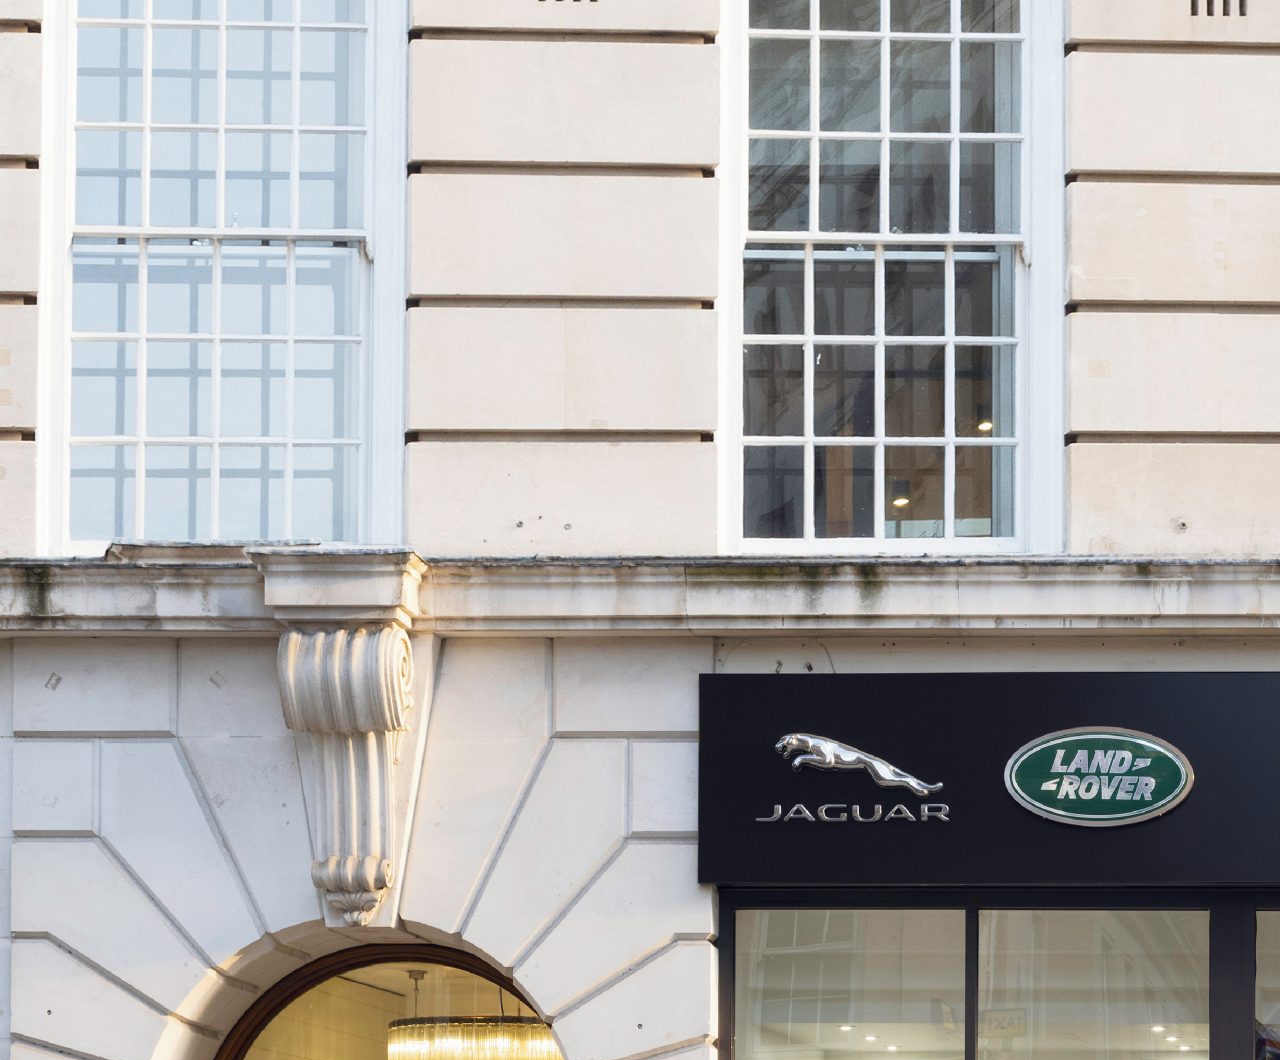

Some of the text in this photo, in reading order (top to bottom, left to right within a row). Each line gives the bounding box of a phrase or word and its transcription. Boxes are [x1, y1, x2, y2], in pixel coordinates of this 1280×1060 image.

[1050, 749, 1133, 773] LAND
[1056, 774, 1156, 800] ROVER
[755, 803, 951, 822] JAGUAR
